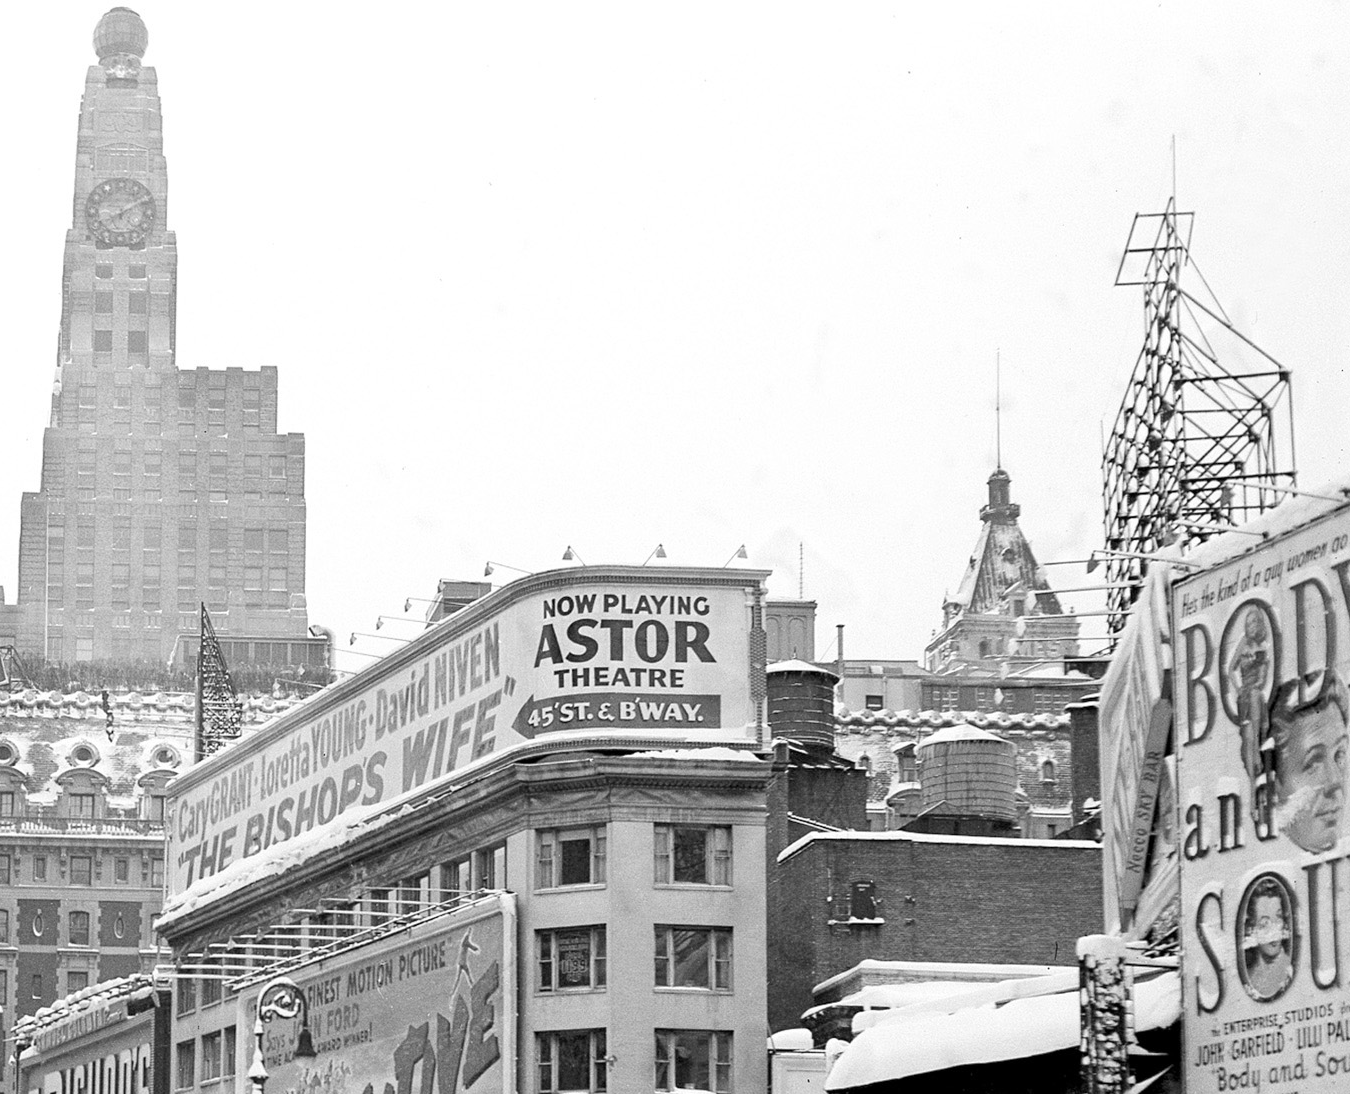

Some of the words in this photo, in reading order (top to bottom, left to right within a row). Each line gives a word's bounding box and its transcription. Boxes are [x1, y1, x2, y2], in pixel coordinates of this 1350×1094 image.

[1217, 570, 1241, 608] kind
[1241, 561, 1254, 593] of
[1253, 570, 1261, 588] a
[1263, 561, 1284, 591] guy
[1285, 542, 1328, 572] women
[543, 593, 598, 620] NOW
[603, 594, 711, 617] PLAYING
[533, 618, 718, 668] ASTOR
[553, 666, 685, 689] THEATRE
[598, 702, 615, 721] &
[178, 793, 209, 844] Cary
[209, 761, 254, 826] GRANT
[260, 738, 310, 800] Loretta
[310, 698, 367, 770] YOUNG
[375, 662, 429, 741] David
[433, 621, 501, 711] NIVEN
[242, 750, 389, 860] BISHOP'S
[306, 975, 341, 1009] FINEST
[346, 958, 394, 998] MOTION
[399, 940, 447, 982] PICTURE
[326, 1002, 360, 1036] FORD
[1223, 1013, 1279, 1036] ENTERPRISE
[1284, 1002, 1334, 1025] STUDIOS
[1194, 1041, 1225, 1068] JOHN
[1231, 1031, 1286, 1061] GARFIELD
[1268, 1053, 1308, 1084] and
